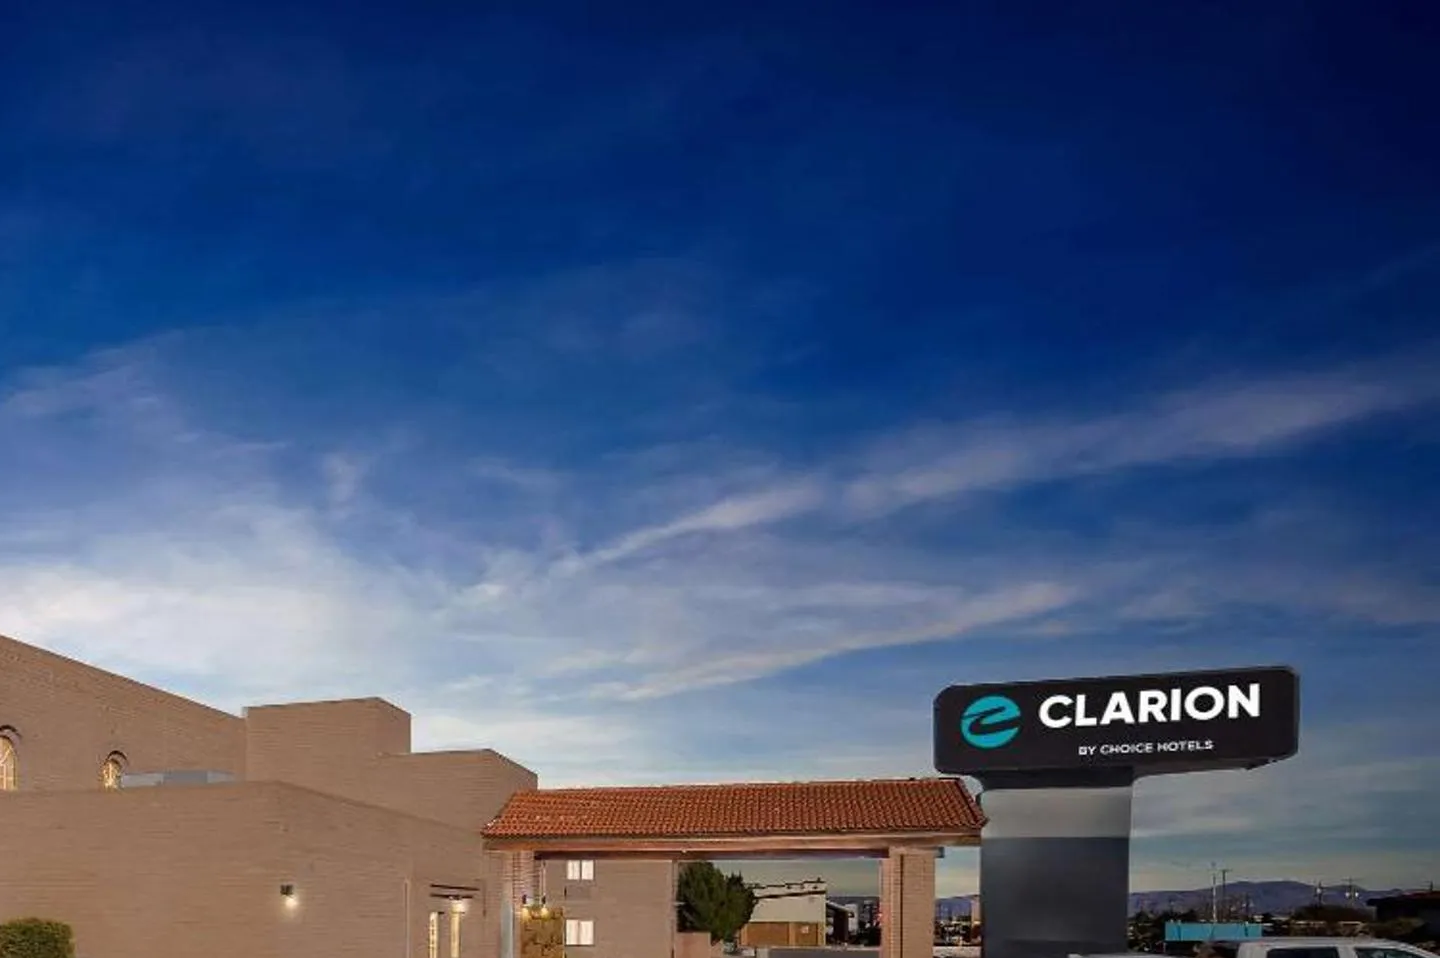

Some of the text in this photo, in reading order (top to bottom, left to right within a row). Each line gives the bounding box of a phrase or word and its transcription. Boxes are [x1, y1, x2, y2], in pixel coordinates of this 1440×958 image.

[1038, 683, 1260, 728] CLARION
[1078, 739, 1214, 755] BY CHOICE HOTELS
